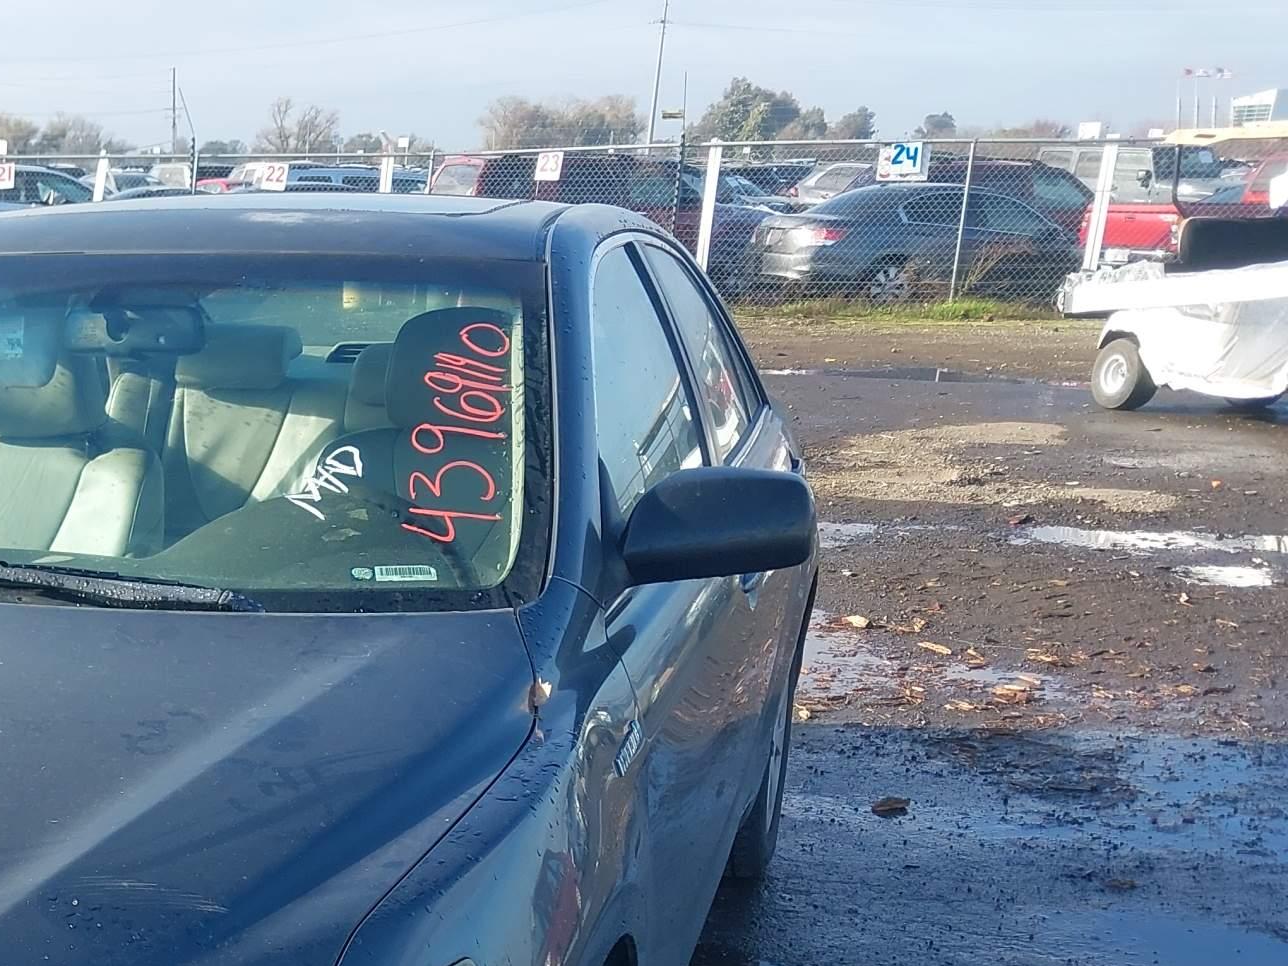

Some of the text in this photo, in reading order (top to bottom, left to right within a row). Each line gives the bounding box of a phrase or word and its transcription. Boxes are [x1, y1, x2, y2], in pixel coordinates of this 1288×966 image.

[539, 154, 560, 172] 23
[891, 143, 919, 168] 24
[265, 165, 285, 183] 22
